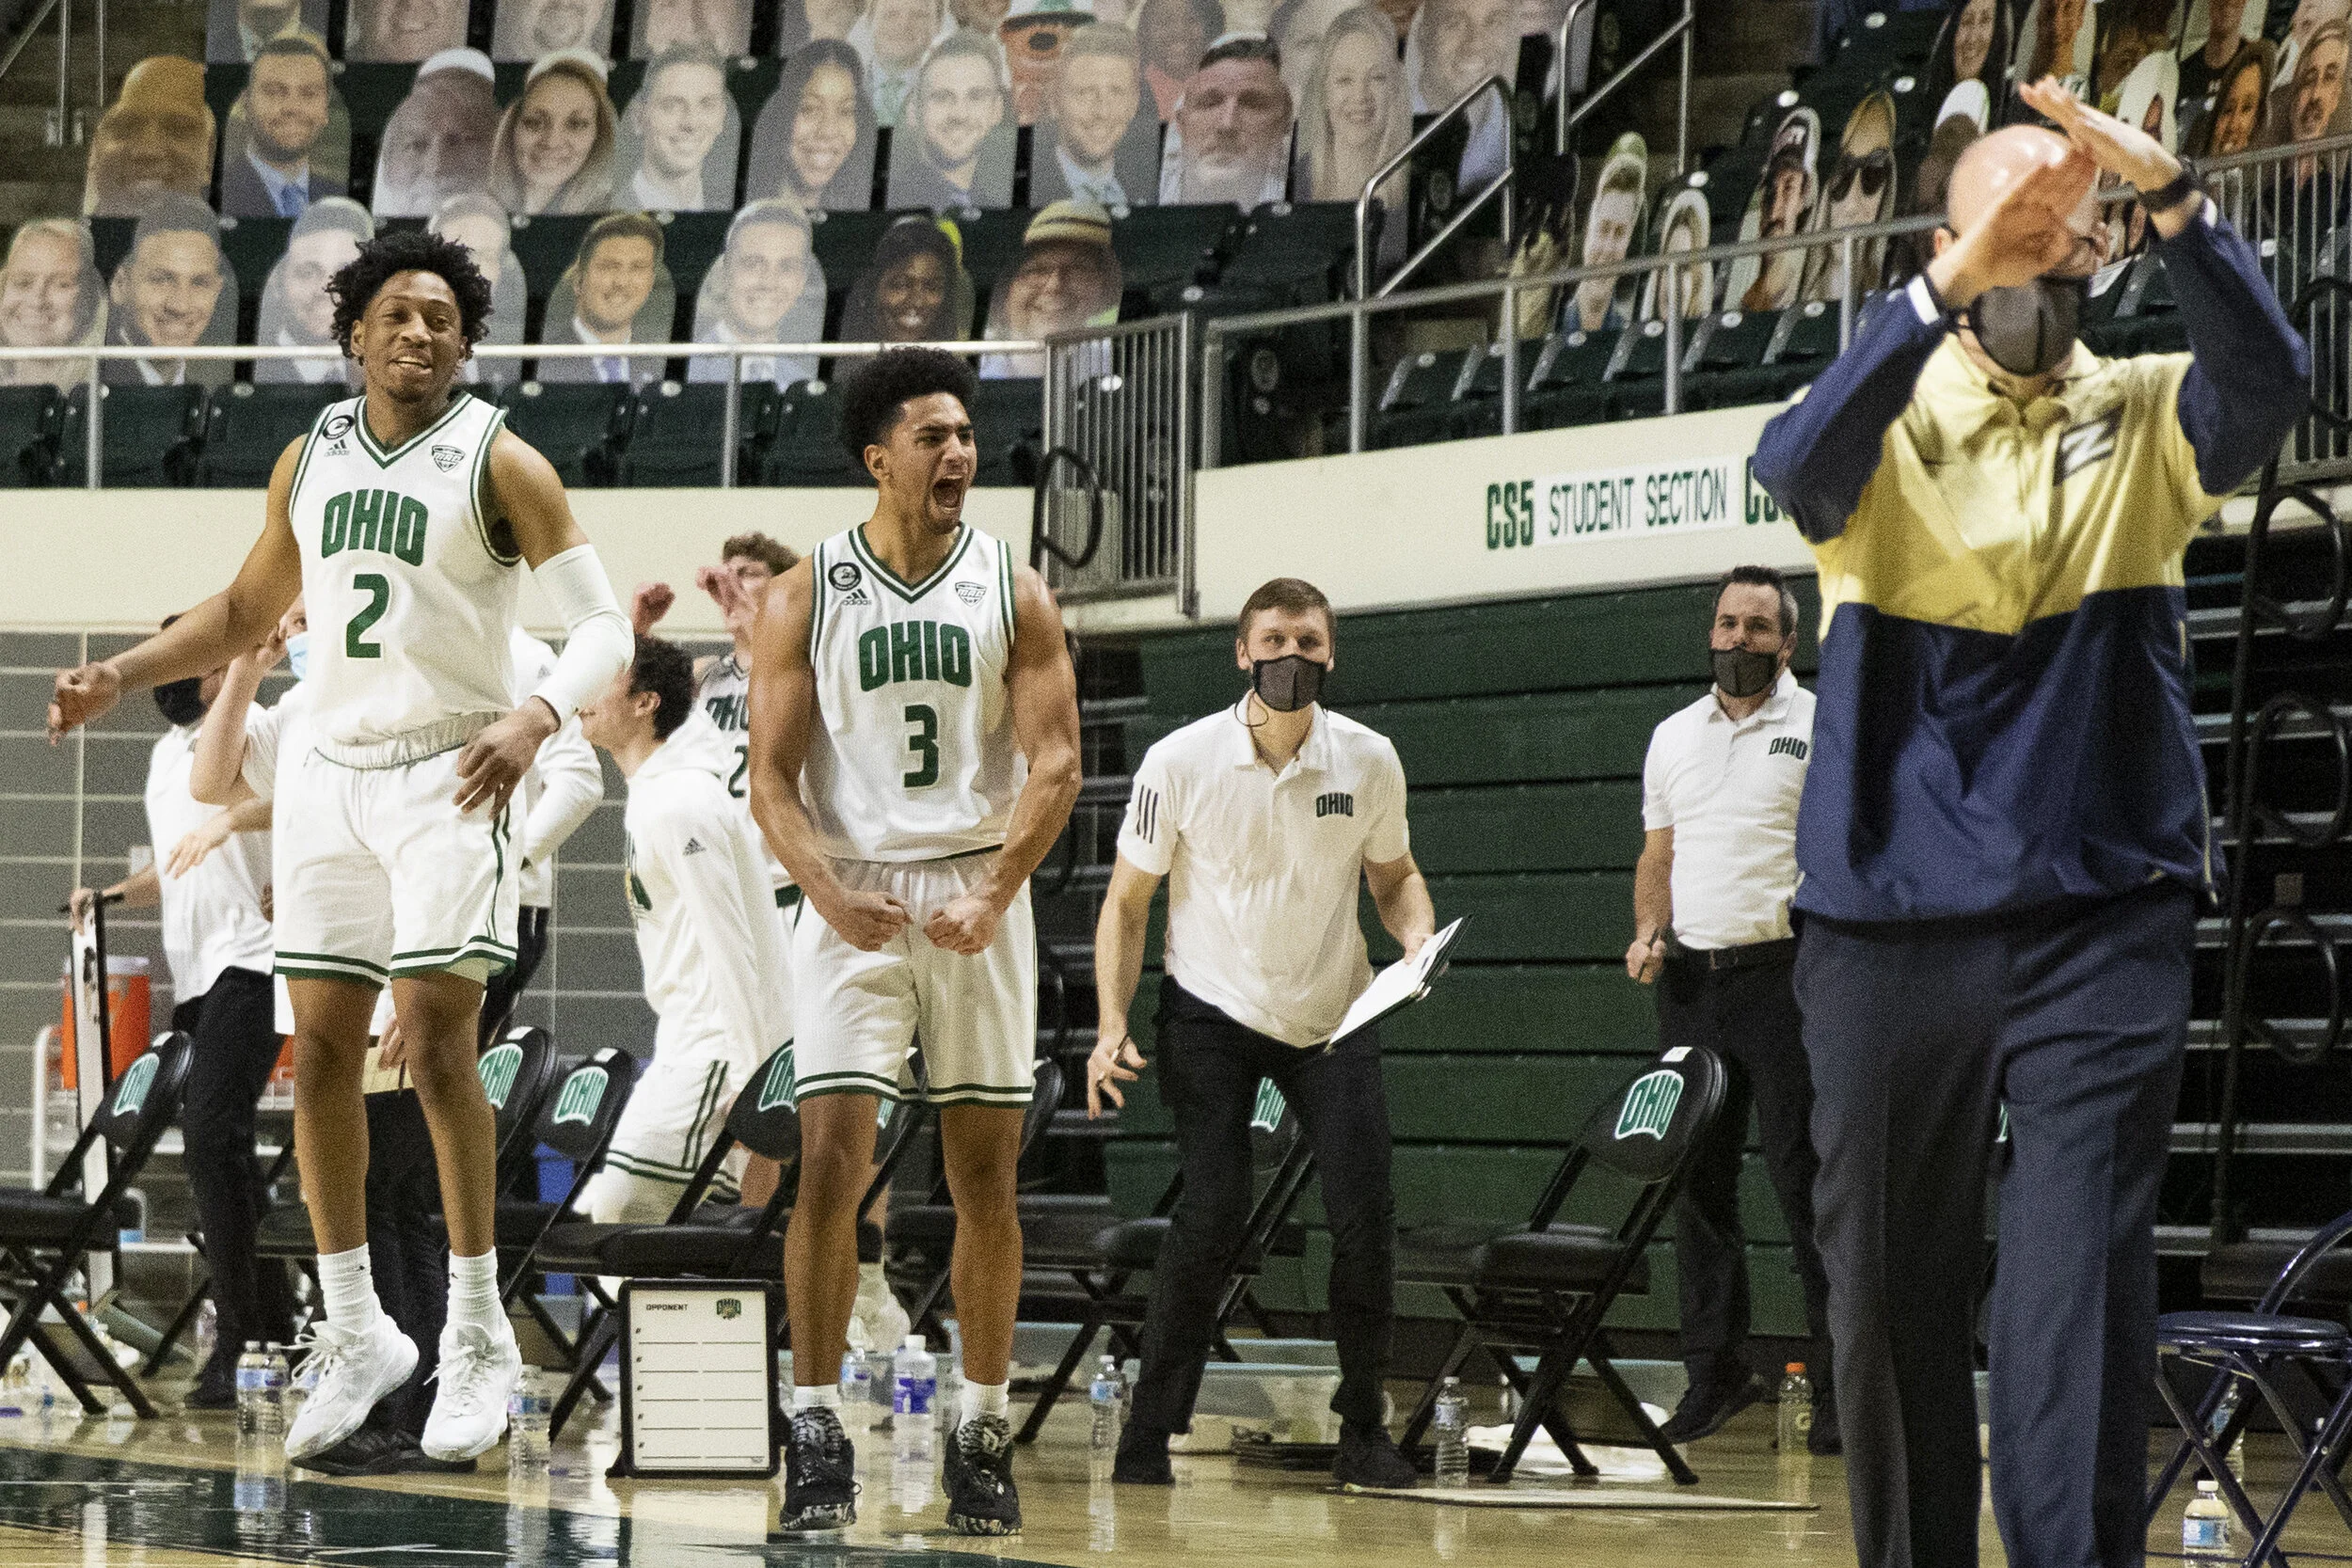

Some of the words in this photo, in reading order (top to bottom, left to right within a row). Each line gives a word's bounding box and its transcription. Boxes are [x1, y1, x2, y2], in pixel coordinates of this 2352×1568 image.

[322, 488, 429, 567] OHIO
[1486, 481, 1534, 549] CS5
[1550, 478, 1635, 536] STUDENT
[1645, 467, 1727, 528] SECTION
[346, 574, 390, 658] 2
[859, 621, 972, 692] OHIO
[903, 704, 939, 788] 3
[1769, 736, 1807, 760] OHIO
[1316, 792, 1353, 817] OHIO
[1615, 1069, 1684, 1140] OHIO
